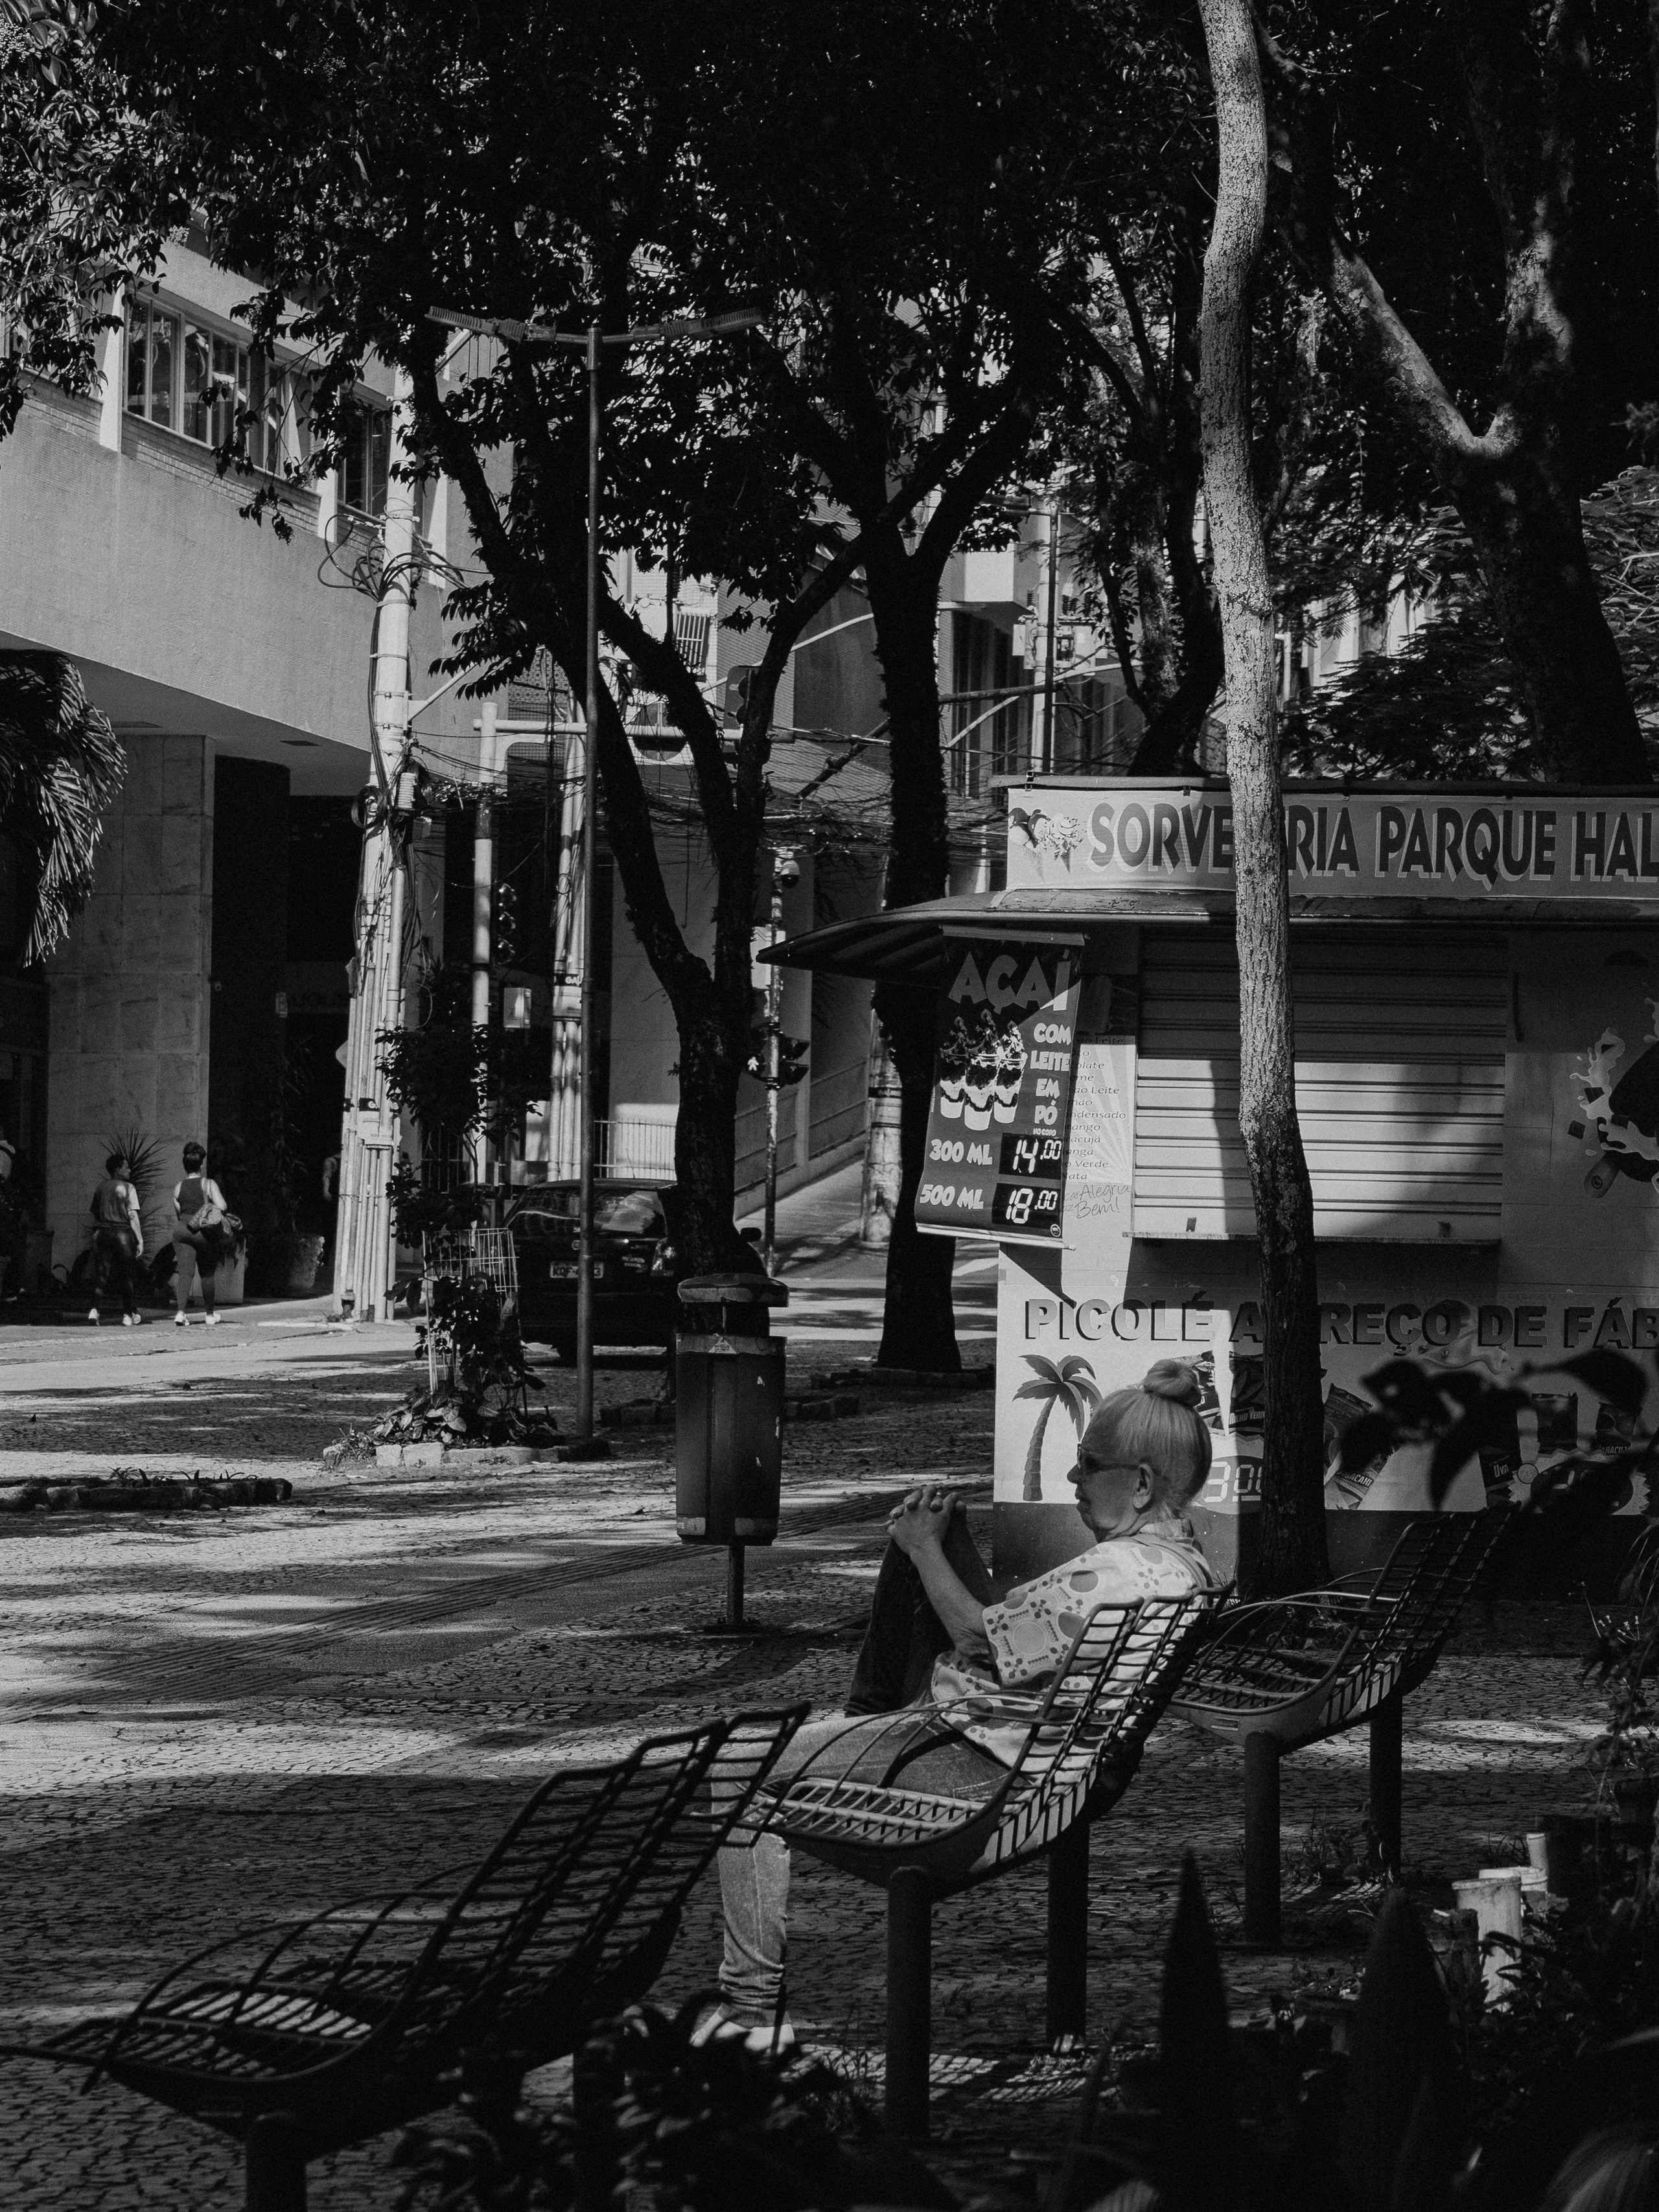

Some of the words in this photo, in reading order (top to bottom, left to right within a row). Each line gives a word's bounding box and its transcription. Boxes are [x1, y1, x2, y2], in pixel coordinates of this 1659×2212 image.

[1087, 803, 1360, 879] SORVERIA
[1375, 806, 1557, 891] PARQUE
[948, 949, 1071, 1014] AÇAÍ
[1034, 1023, 1072, 1045] COM
[1030, 1050, 1071, 1071] LEITE
[1036, 1078, 1060, 1099] EM
[1034, 1100, 1058, 1125] PÓ
[1067, 1124, 1100, 1133] rango
[1066, 1135, 1100, 1145] racujá
[929, 1139, 964, 1163] 300
[966, 1142, 993, 1165] ML
[1066, 1149, 1093, 1158] anga
[920, 1184, 955, 1206] 500
[957, 1187, 984, 1209] ML
[1079, 1185, 1130, 1203] Alegria
[1074, 1196, 1120, 1218] Bem!
[1025, 1290, 1214, 1341] PICOLÉ
[1229, 1301, 1264, 1343] A
[1320, 1302, 1461, 1356] REÇO
[1477, 1305, 1548, 1347] DE
[1249, 1408, 1265, 1420] VERD
